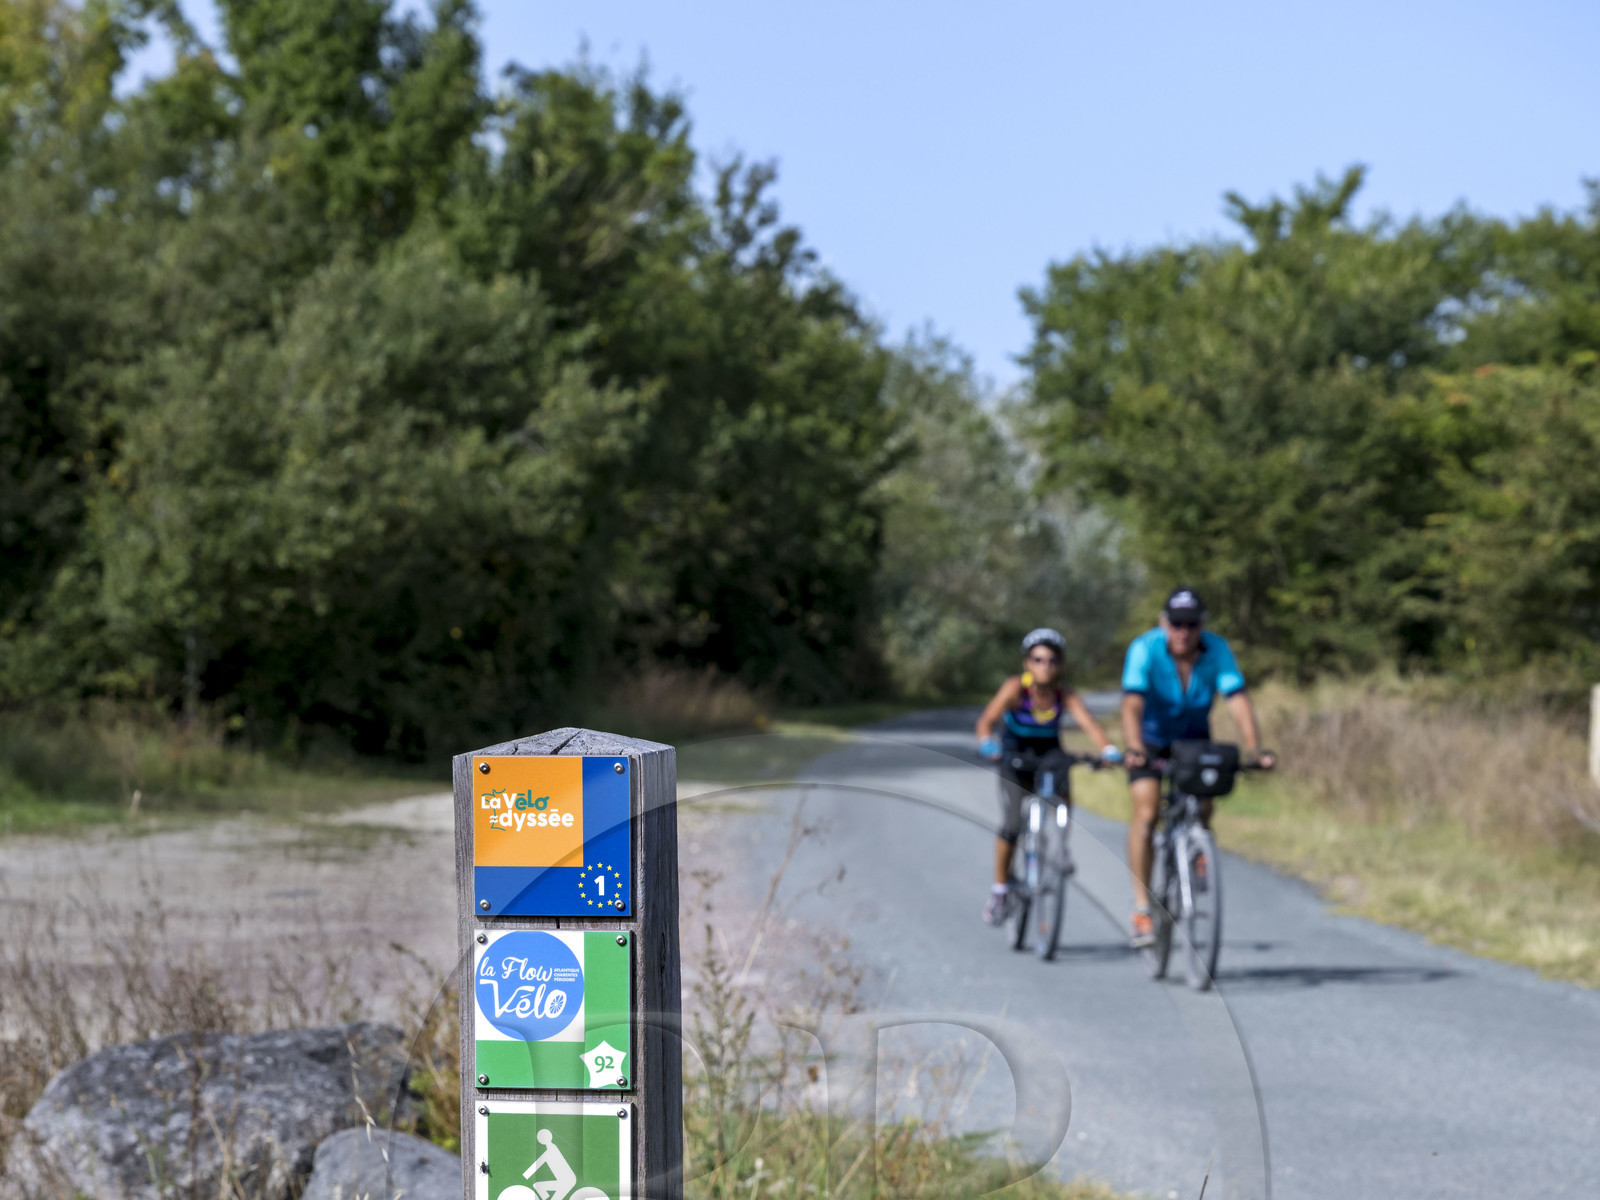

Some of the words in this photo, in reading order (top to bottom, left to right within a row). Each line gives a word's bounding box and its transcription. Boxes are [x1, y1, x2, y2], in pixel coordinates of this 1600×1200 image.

[594, 875, 605, 896] 1
[480, 956, 496, 977] la
[501, 956, 553, 982] Flow
[479, 978, 567, 1019] Vélo
[594, 1055, 615, 1074] 92
